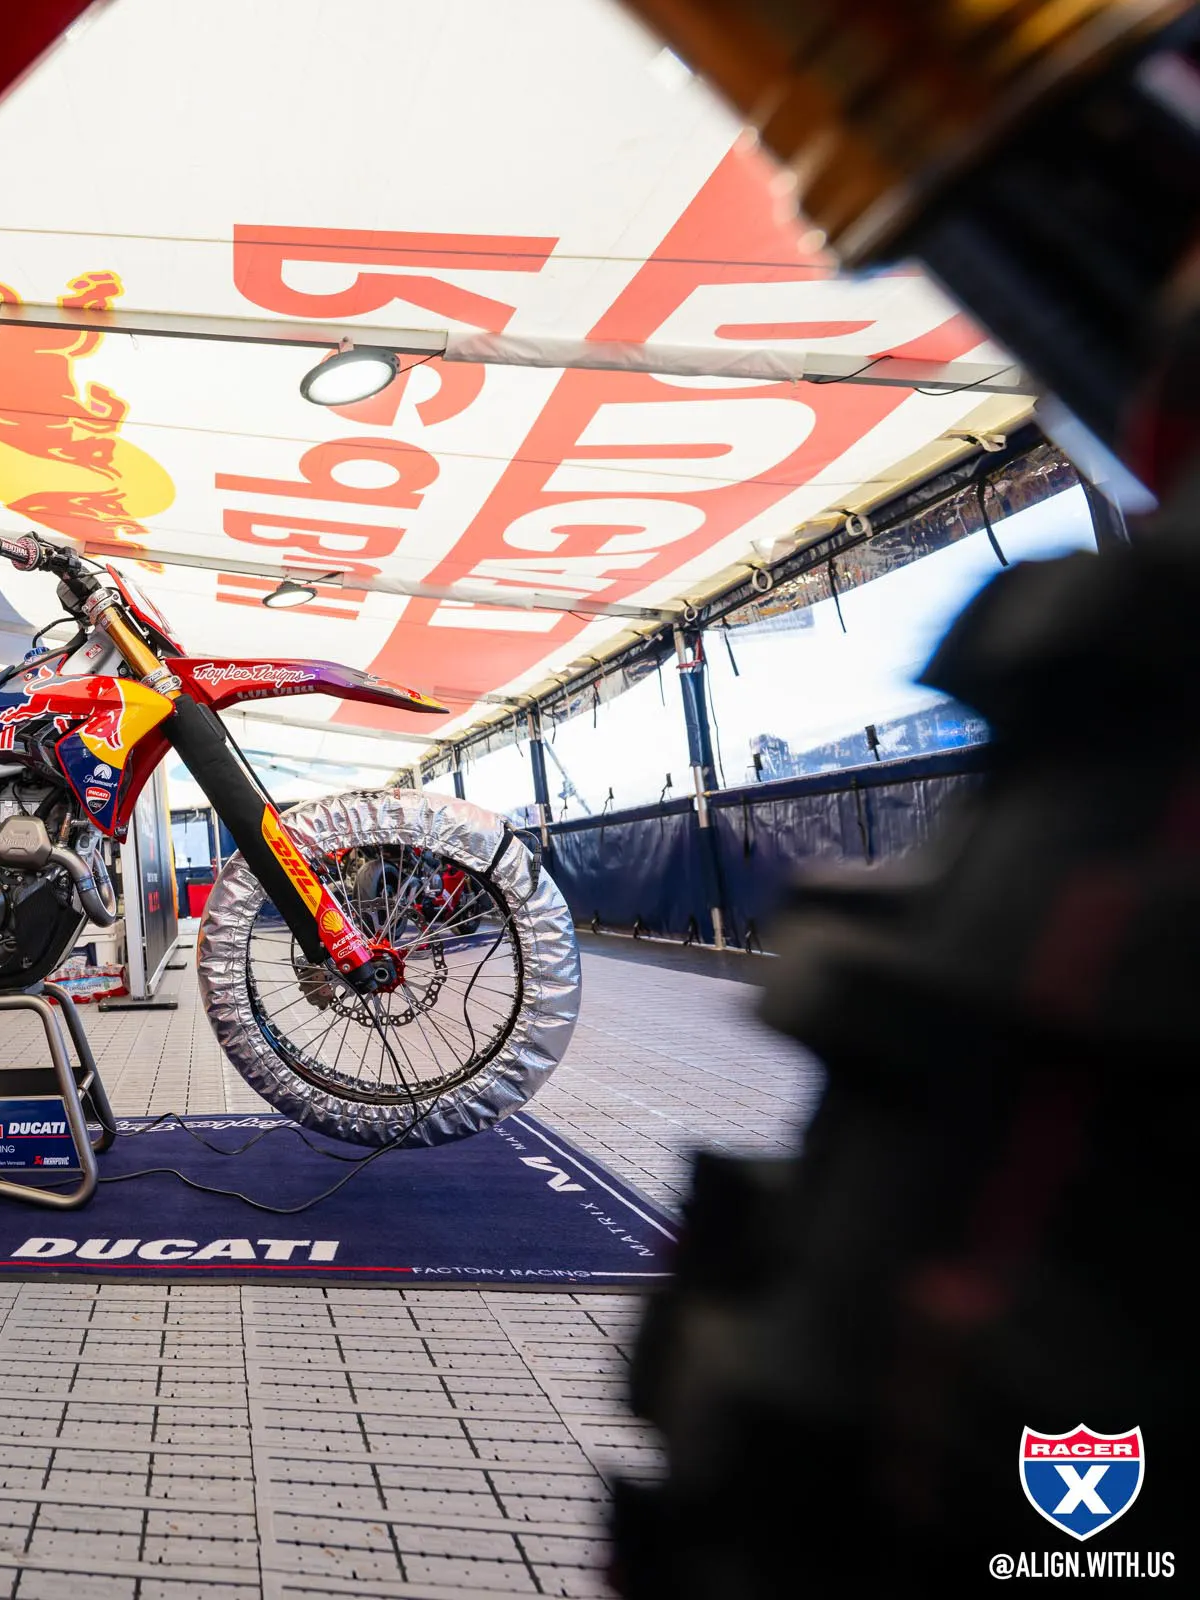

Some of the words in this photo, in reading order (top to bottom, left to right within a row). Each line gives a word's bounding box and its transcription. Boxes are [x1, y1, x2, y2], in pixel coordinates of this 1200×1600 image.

[193, 663, 228, 685] Troy
[226, 665, 251, 680] Lee
[251, 664, 316, 687] Designs
[87, 789, 109, 798] DUCATI
[269, 836, 315, 895] DHL
[8, 1121, 66, 1135] DUCATI
[580, 1202, 655, 1257] MATRIX
[10, 1238, 340, 1262] DUCATI
[412, 1266, 506, 1276] FACTORY
[511, 1268, 591, 1278] RACING
